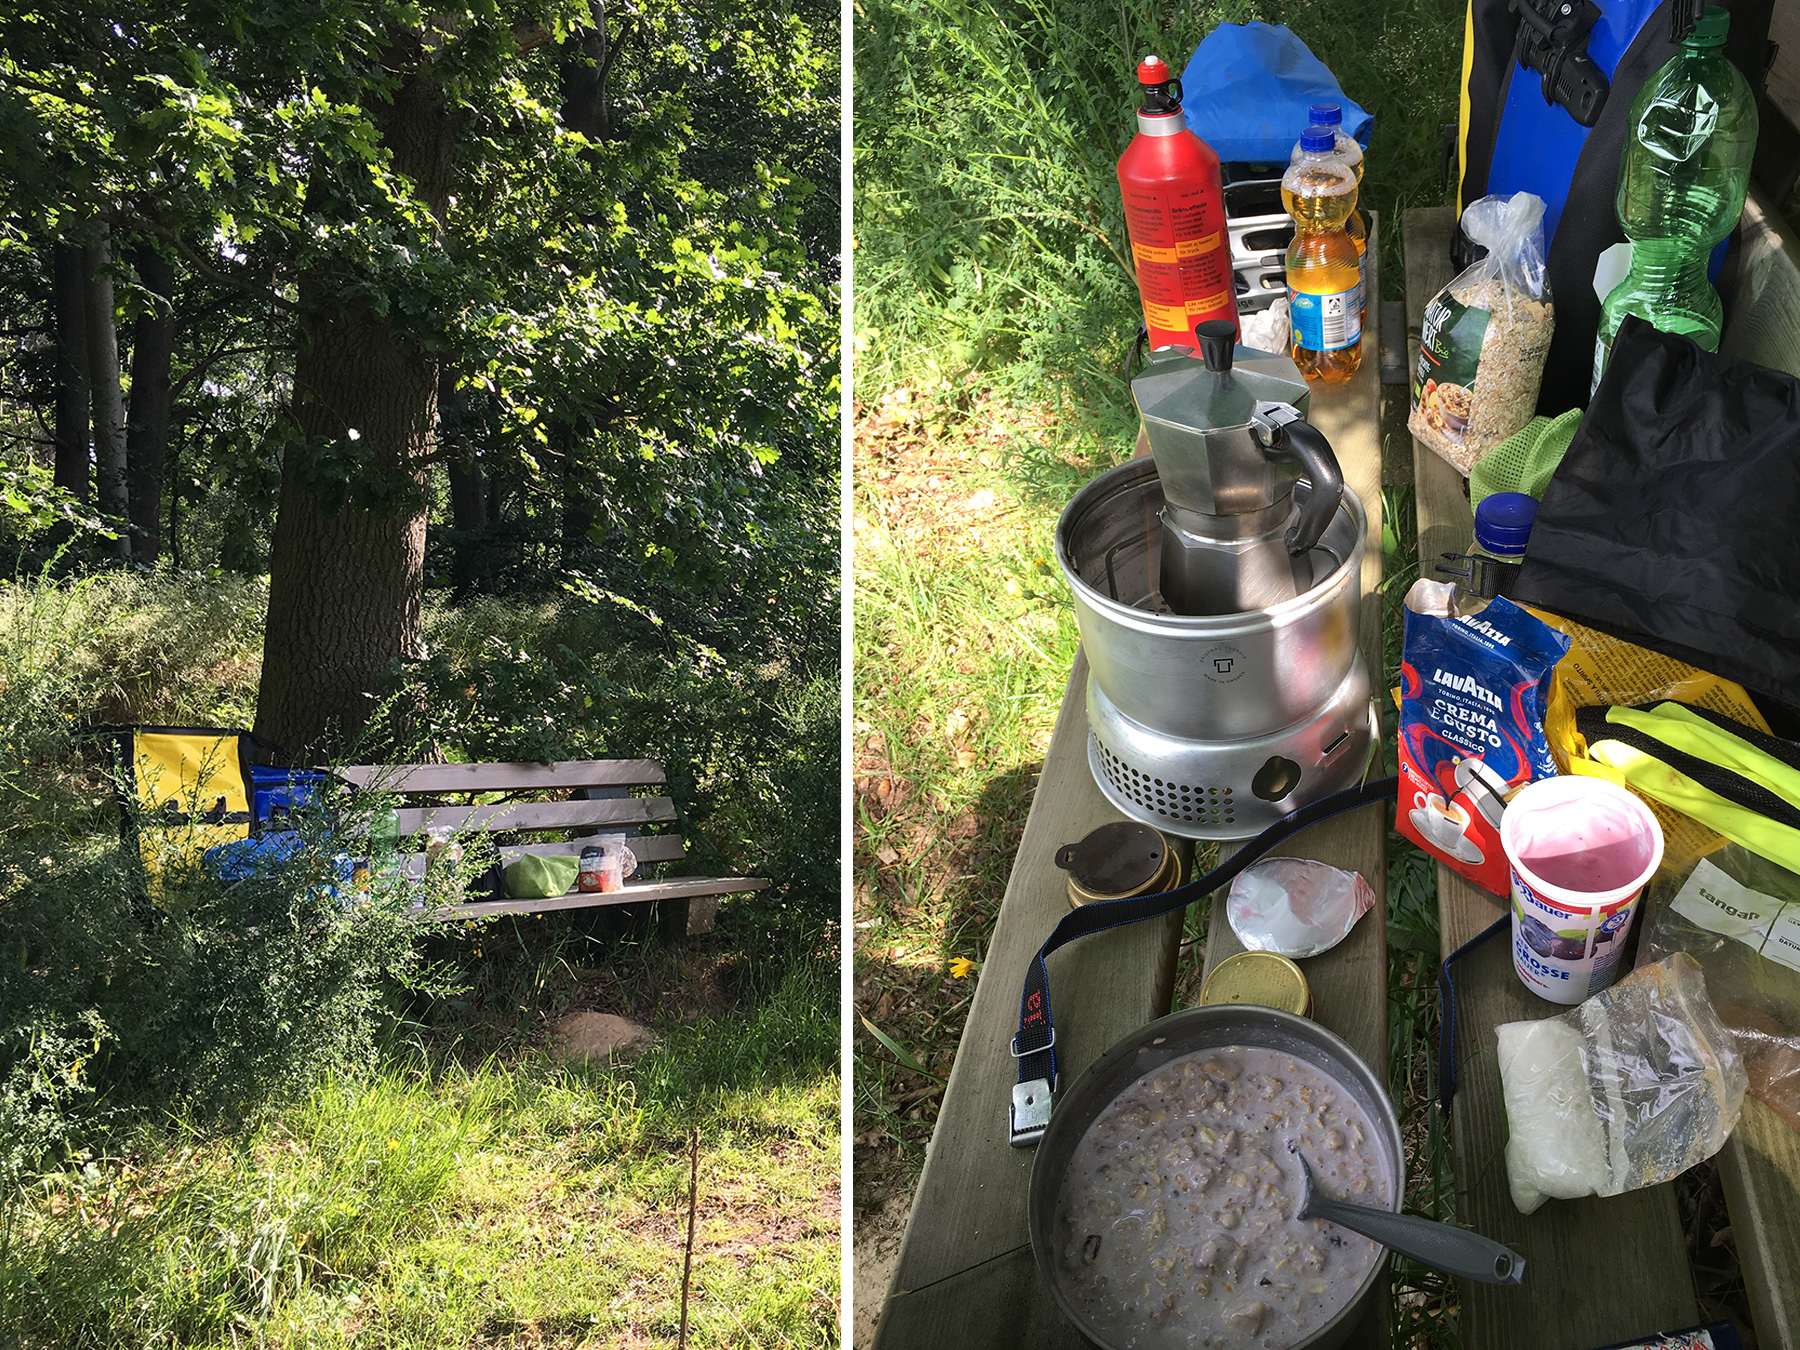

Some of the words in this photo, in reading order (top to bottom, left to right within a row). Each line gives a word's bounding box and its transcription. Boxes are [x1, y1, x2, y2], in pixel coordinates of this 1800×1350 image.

[1434, 338, 1450, 356] Bio
[1433, 668, 1503, 713] LAVAZZA
[1572, 661, 1593, 686] SPIRITO
[1434, 699, 1499, 733] CREMA
[1438, 688, 1462, 704] TORINO,
[1462, 698, 1483, 711] ITALIA,
[1430, 706, 1440, 720] E
[1443, 712, 1502, 748] GUSTO
[1442, 729, 1486, 753] CLASSICO
[1520, 880, 1572, 920] Bauer
[1516, 940, 1570, 980] GROSSE
